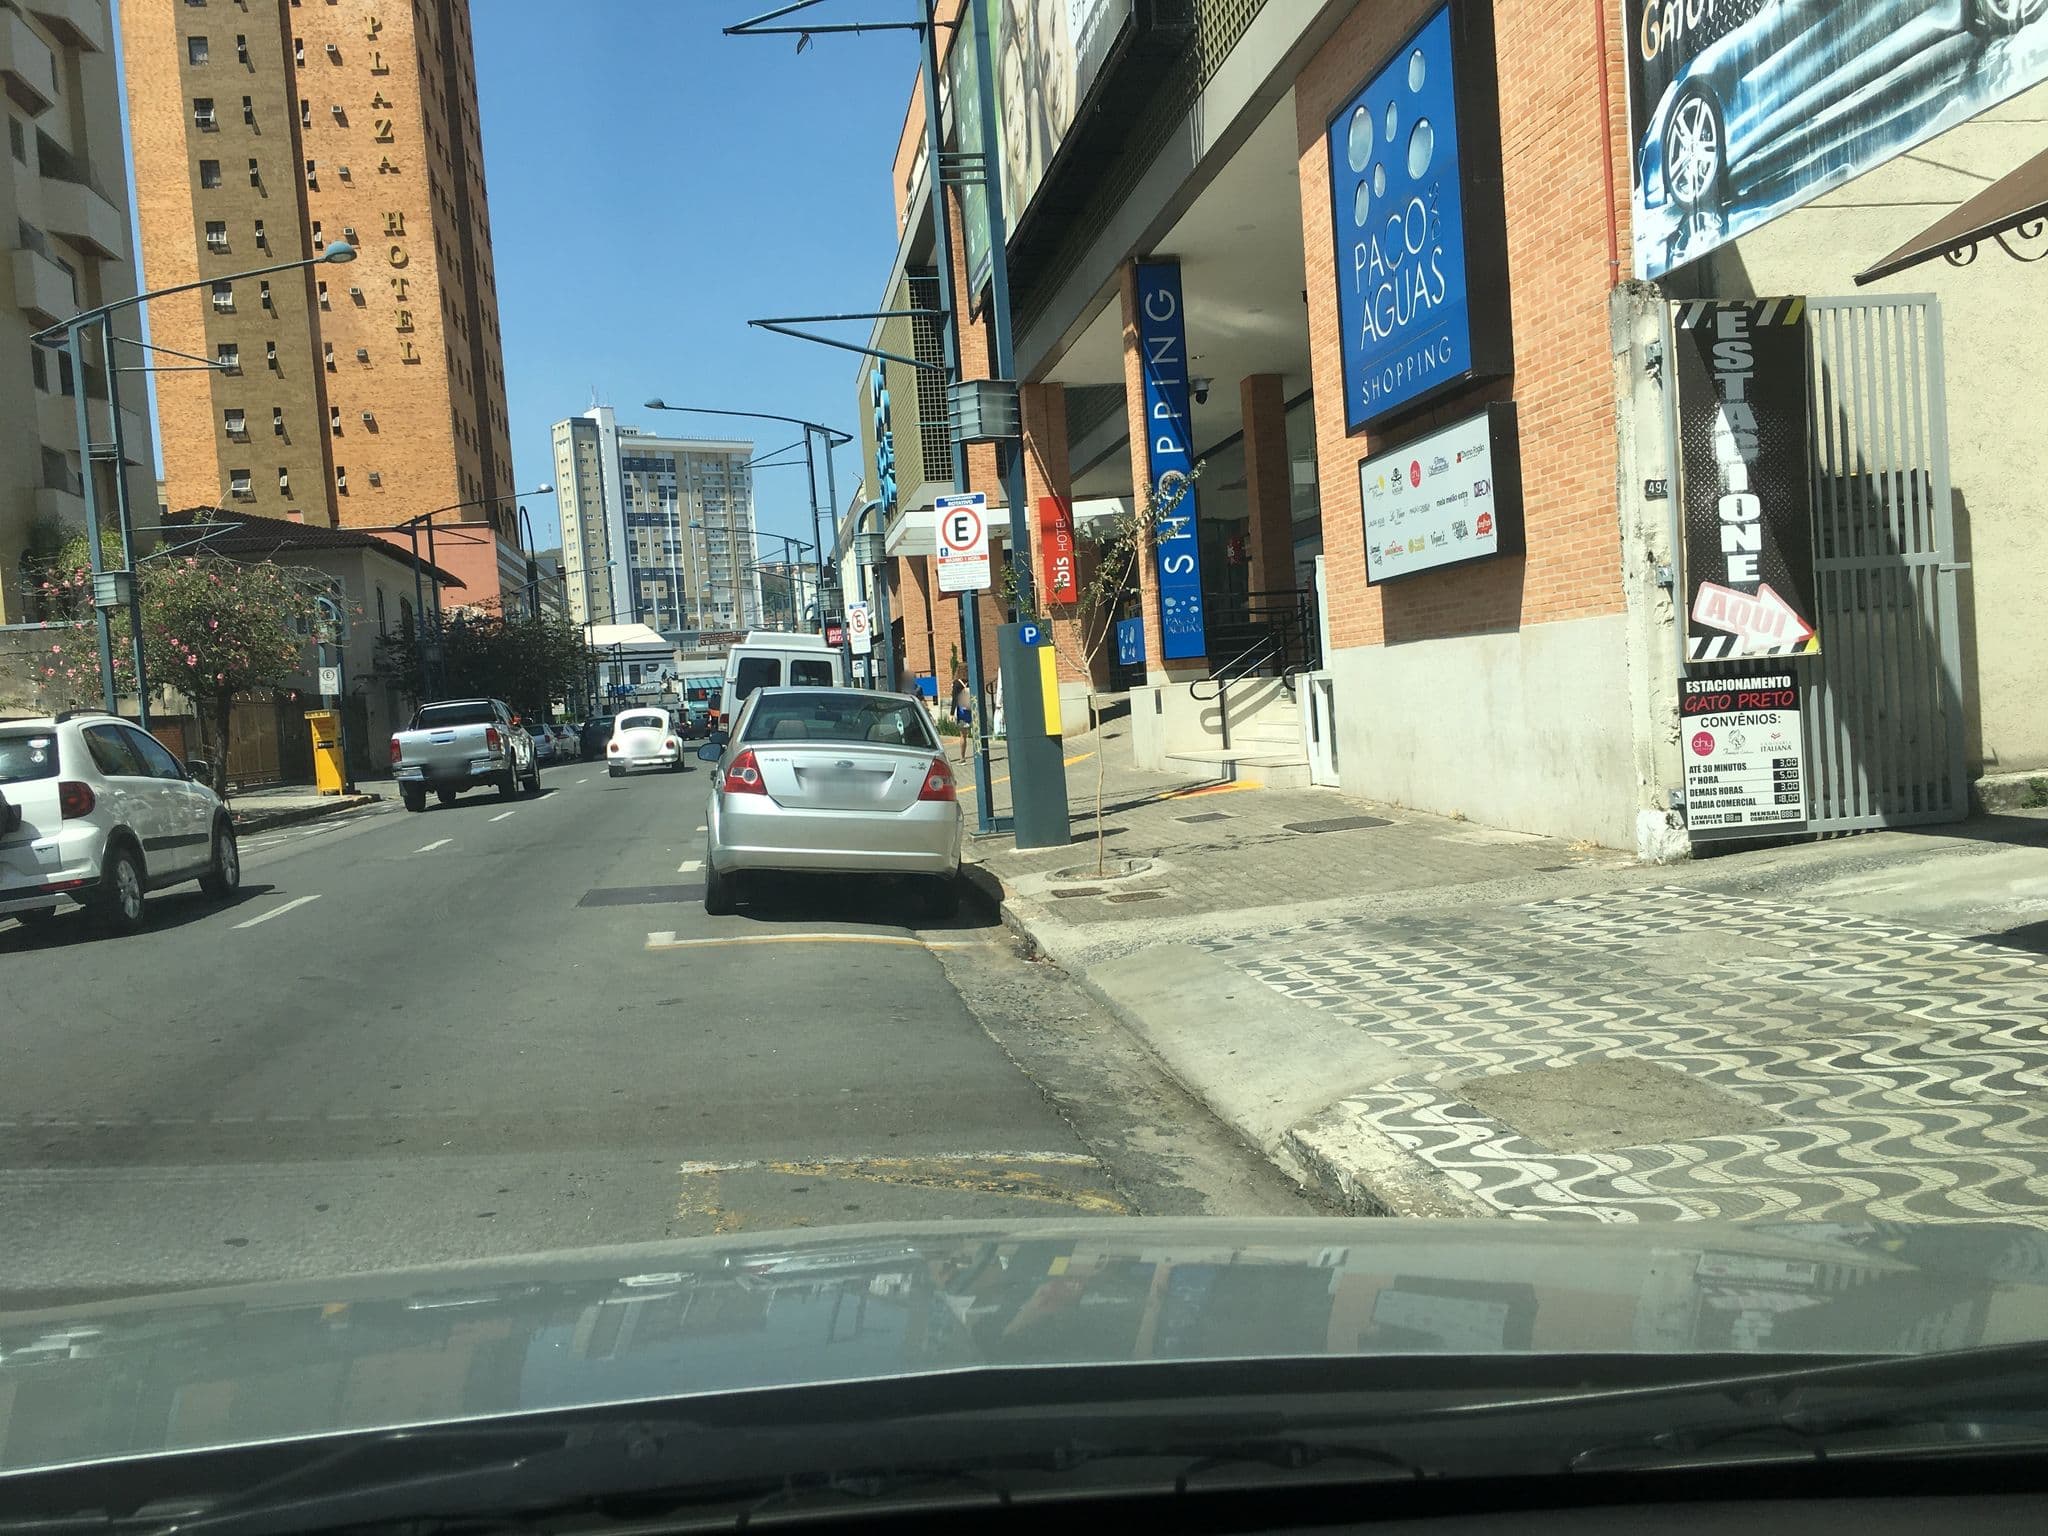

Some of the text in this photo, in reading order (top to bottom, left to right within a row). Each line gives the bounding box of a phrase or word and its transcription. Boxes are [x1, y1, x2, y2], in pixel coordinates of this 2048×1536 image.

[364, 15, 422, 366] PLAZA HOTEL
[1354, 197, 1427, 294] PAÇO
[1362, 336, 1452, 405] SHOPPING
[1144, 288, 1195, 575] SHOPPING
[954, 516, 969, 542] E
[1053, 515, 1071, 588] ibis HOTEL
[1704, 592, 1787, 640] AQUI
[1024, 627, 1037, 642] P
[1685, 675, 1792, 694] ESTACIONAMENTO
[1684, 690, 1795, 713] GATO PRETO
[1700, 712, 1781, 729] CONVÊNIOS:
[1760, 745, 1792, 753] ITALIANA
[1703, 764, 1713, 773] 30
[1713, 762, 1747, 772] MINUTOS
[1697, 775, 1720, 784] HORA
[1689, 787, 1718, 798] DEMAIS
[1720, 785, 1744, 795] HORAS
[1715, 797, 1757, 808] COMERCIAL
